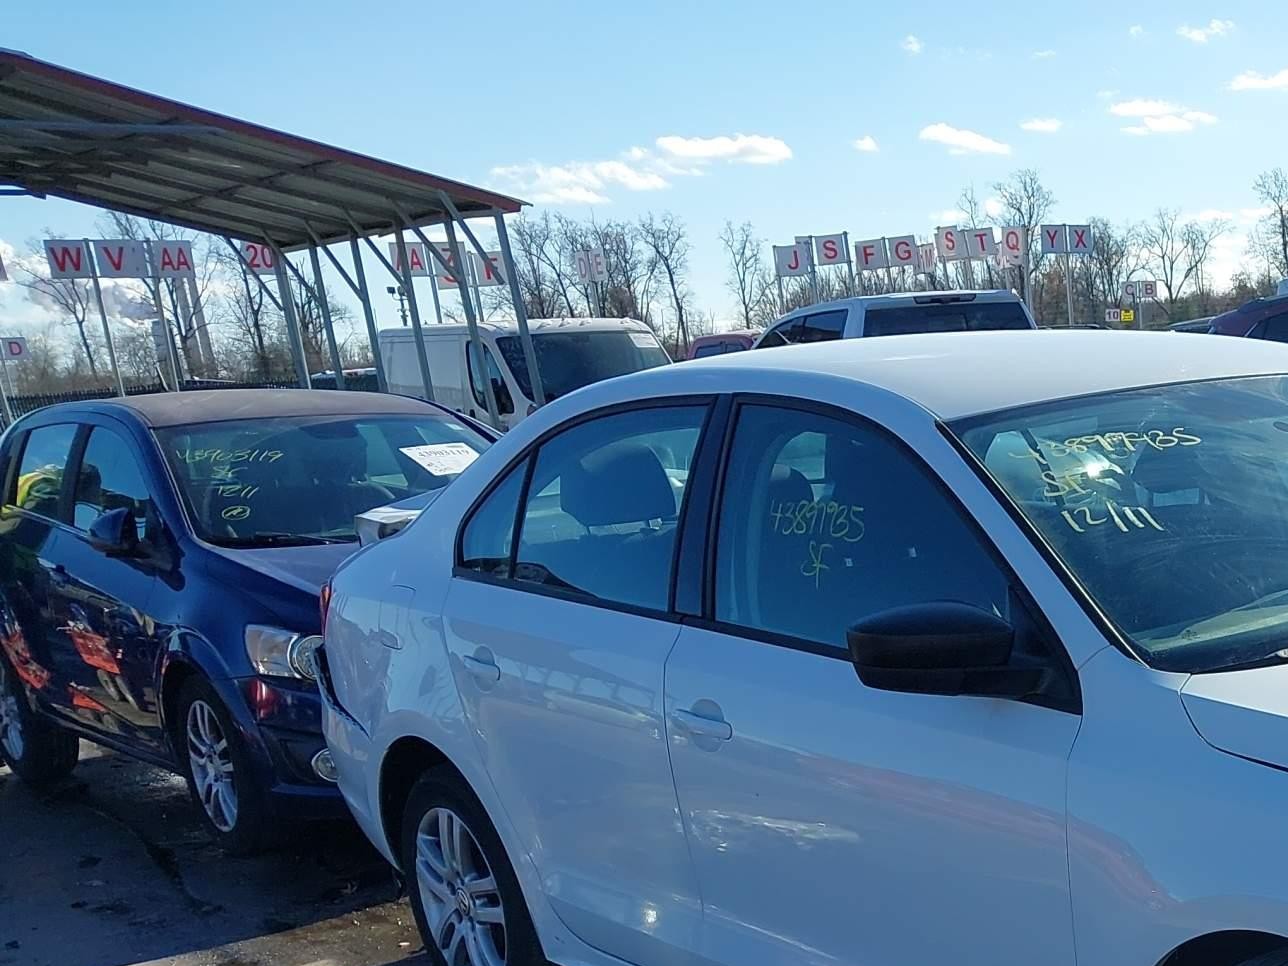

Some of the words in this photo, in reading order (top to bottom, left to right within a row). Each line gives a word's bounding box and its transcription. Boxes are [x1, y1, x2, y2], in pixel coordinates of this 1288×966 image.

[944, 231, 955, 250] S
[975, 233, 987, 251] T
[1006, 231, 1020, 251] Q
[1046, 230, 1058, 249] Y
[1074, 230, 1088, 249] X
[103, 247, 124, 271] V
[161, 247, 191, 271] AA
[822, 240, 838, 259] S
[863, 245, 875, 265] F
[895, 241, 912, 261] G
[51, 247, 81, 272] W
[788, 250, 799, 270] J
[1125, 284, 1134, 296] C
[1145, 283, 1154, 295] B
[8, 341, 22, 356] D
[1060, 500, 1166, 532] 12/11
